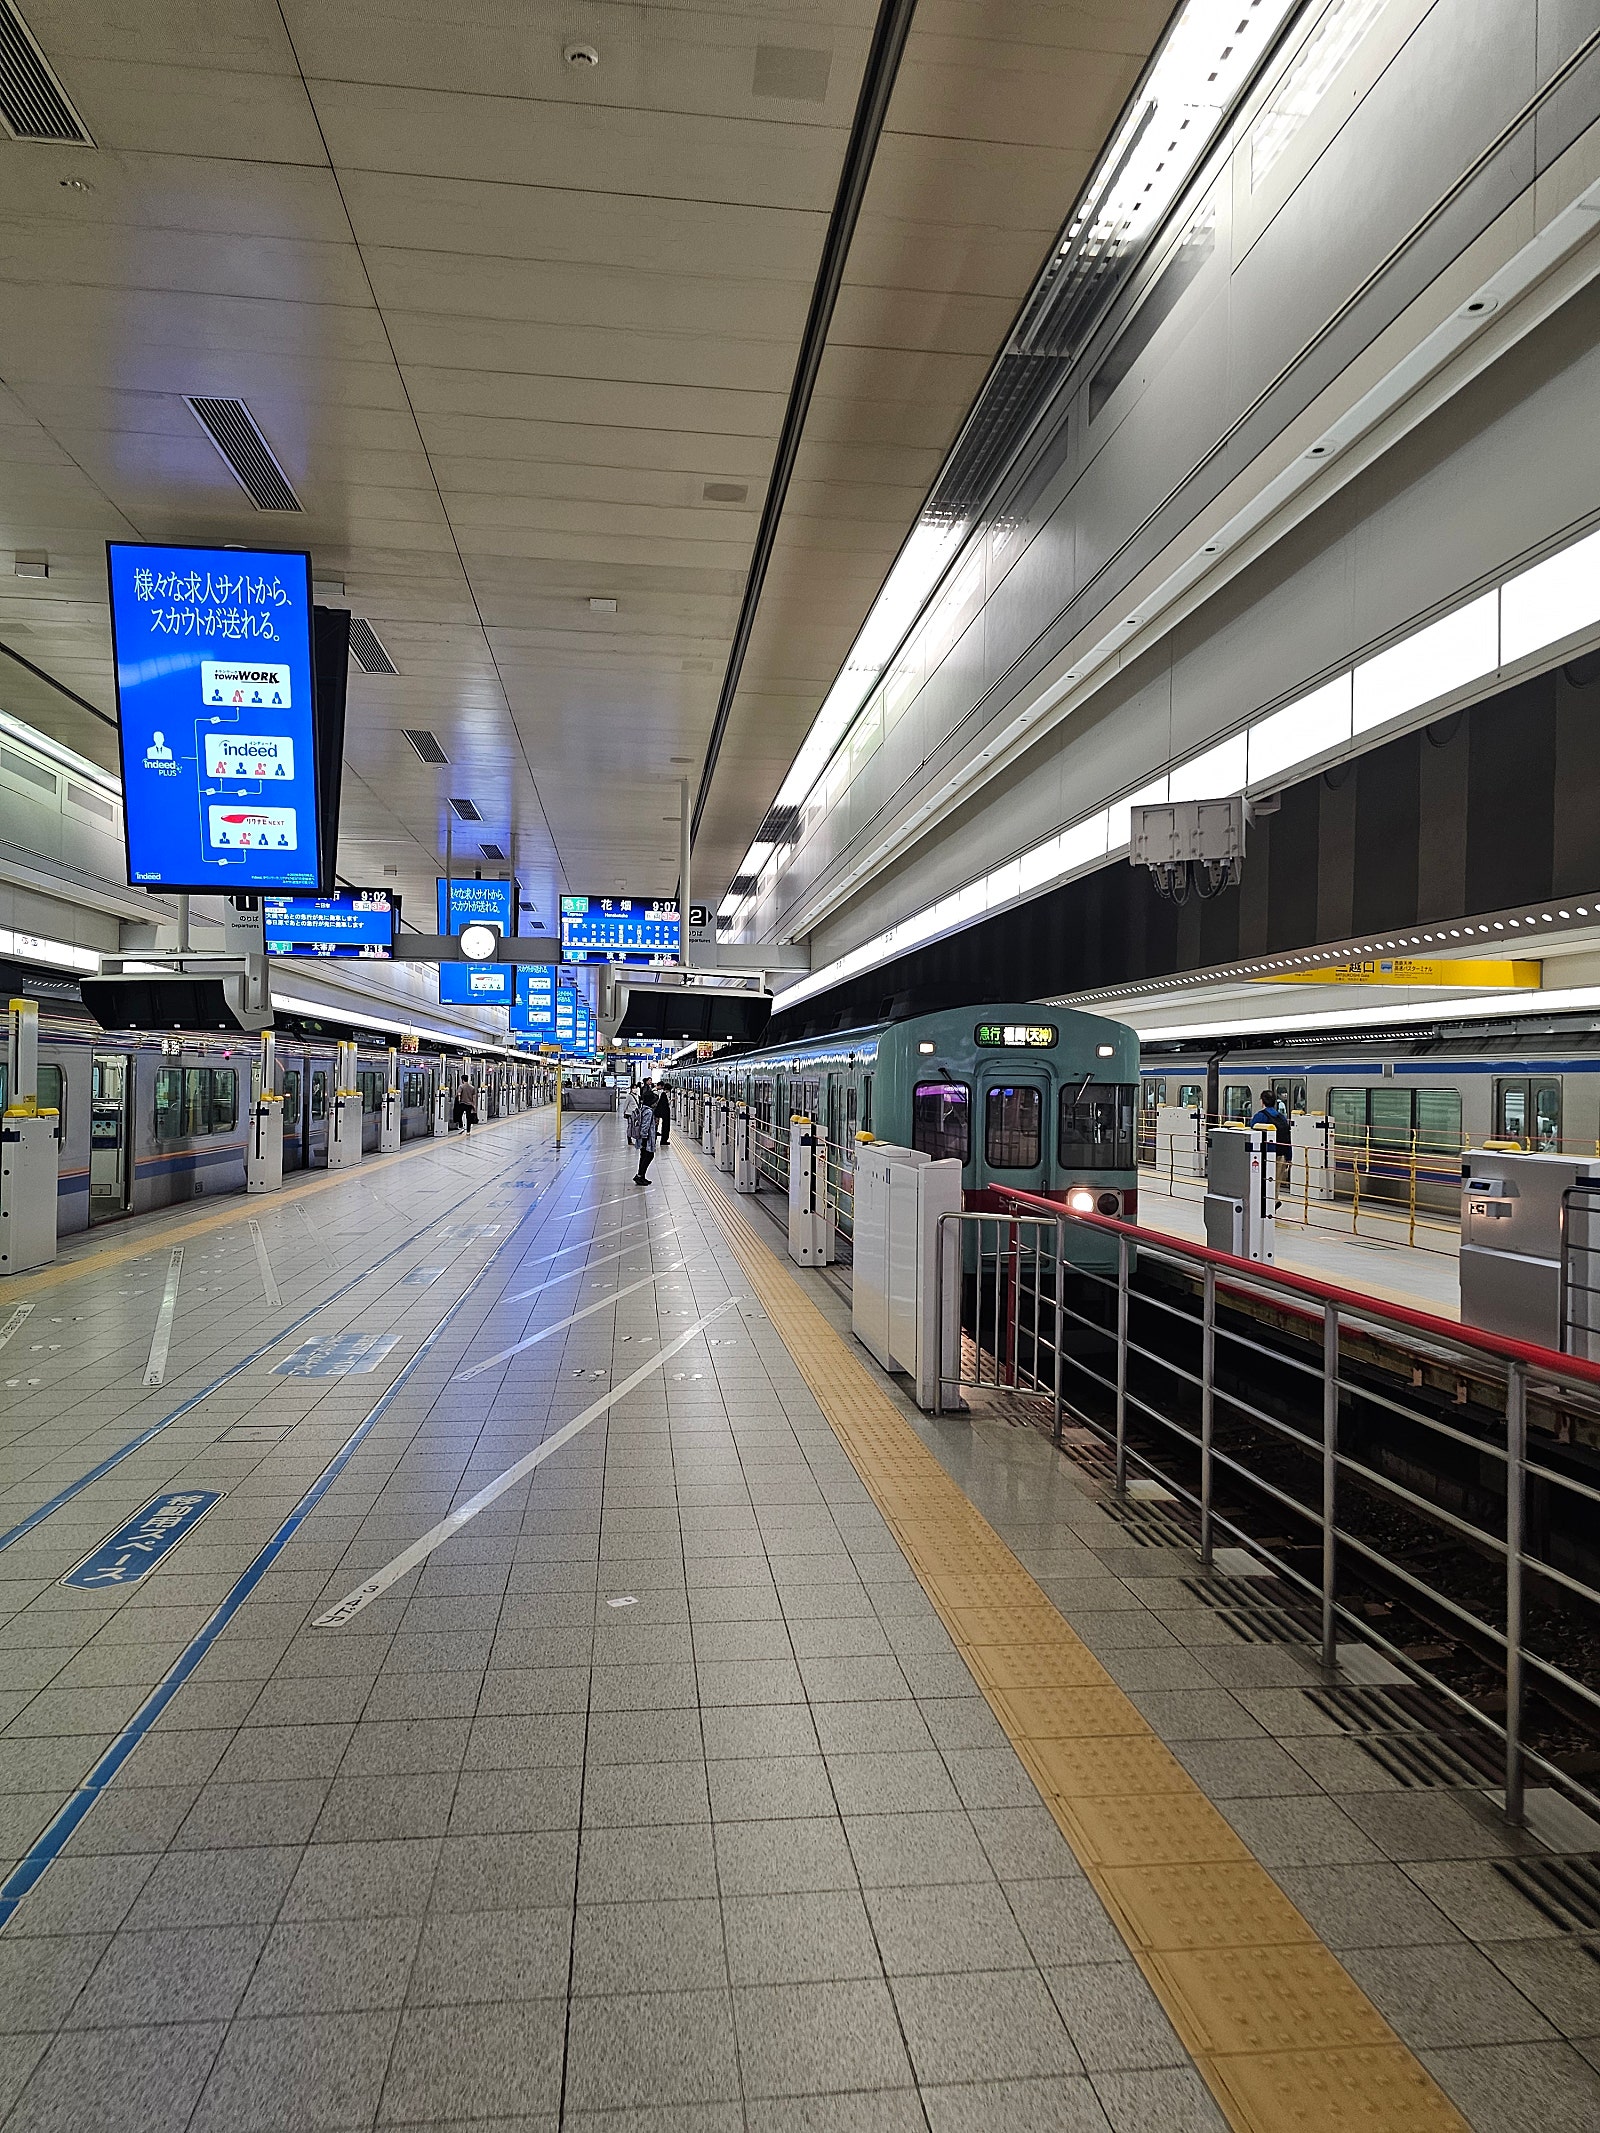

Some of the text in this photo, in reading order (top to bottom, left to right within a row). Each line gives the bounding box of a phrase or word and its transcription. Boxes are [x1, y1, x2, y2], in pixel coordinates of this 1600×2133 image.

[133, 567, 293, 607] 様々な求人サイトから、
[150, 606, 282, 643] スカウトが送れる。
[223, 743, 278, 758] indeed
[143, 759, 176, 769] indeed
[158, 769, 177, 777] PLUS
[136, 872, 161, 881] indeed
[361, 891, 387, 902] 9:02
[451, 901, 500, 914] スカウトが送れる。
[563, 898, 587, 911] 急行
[600, 898, 632, 912] 花畑
[652, 901, 677, 912] 9:07
[690, 909, 702, 924] 2
[364, 945, 383, 953] 9:18
[979, 1026, 1001, 1041] 急行
[82, 1494, 206, 1581] 移動用スペース
